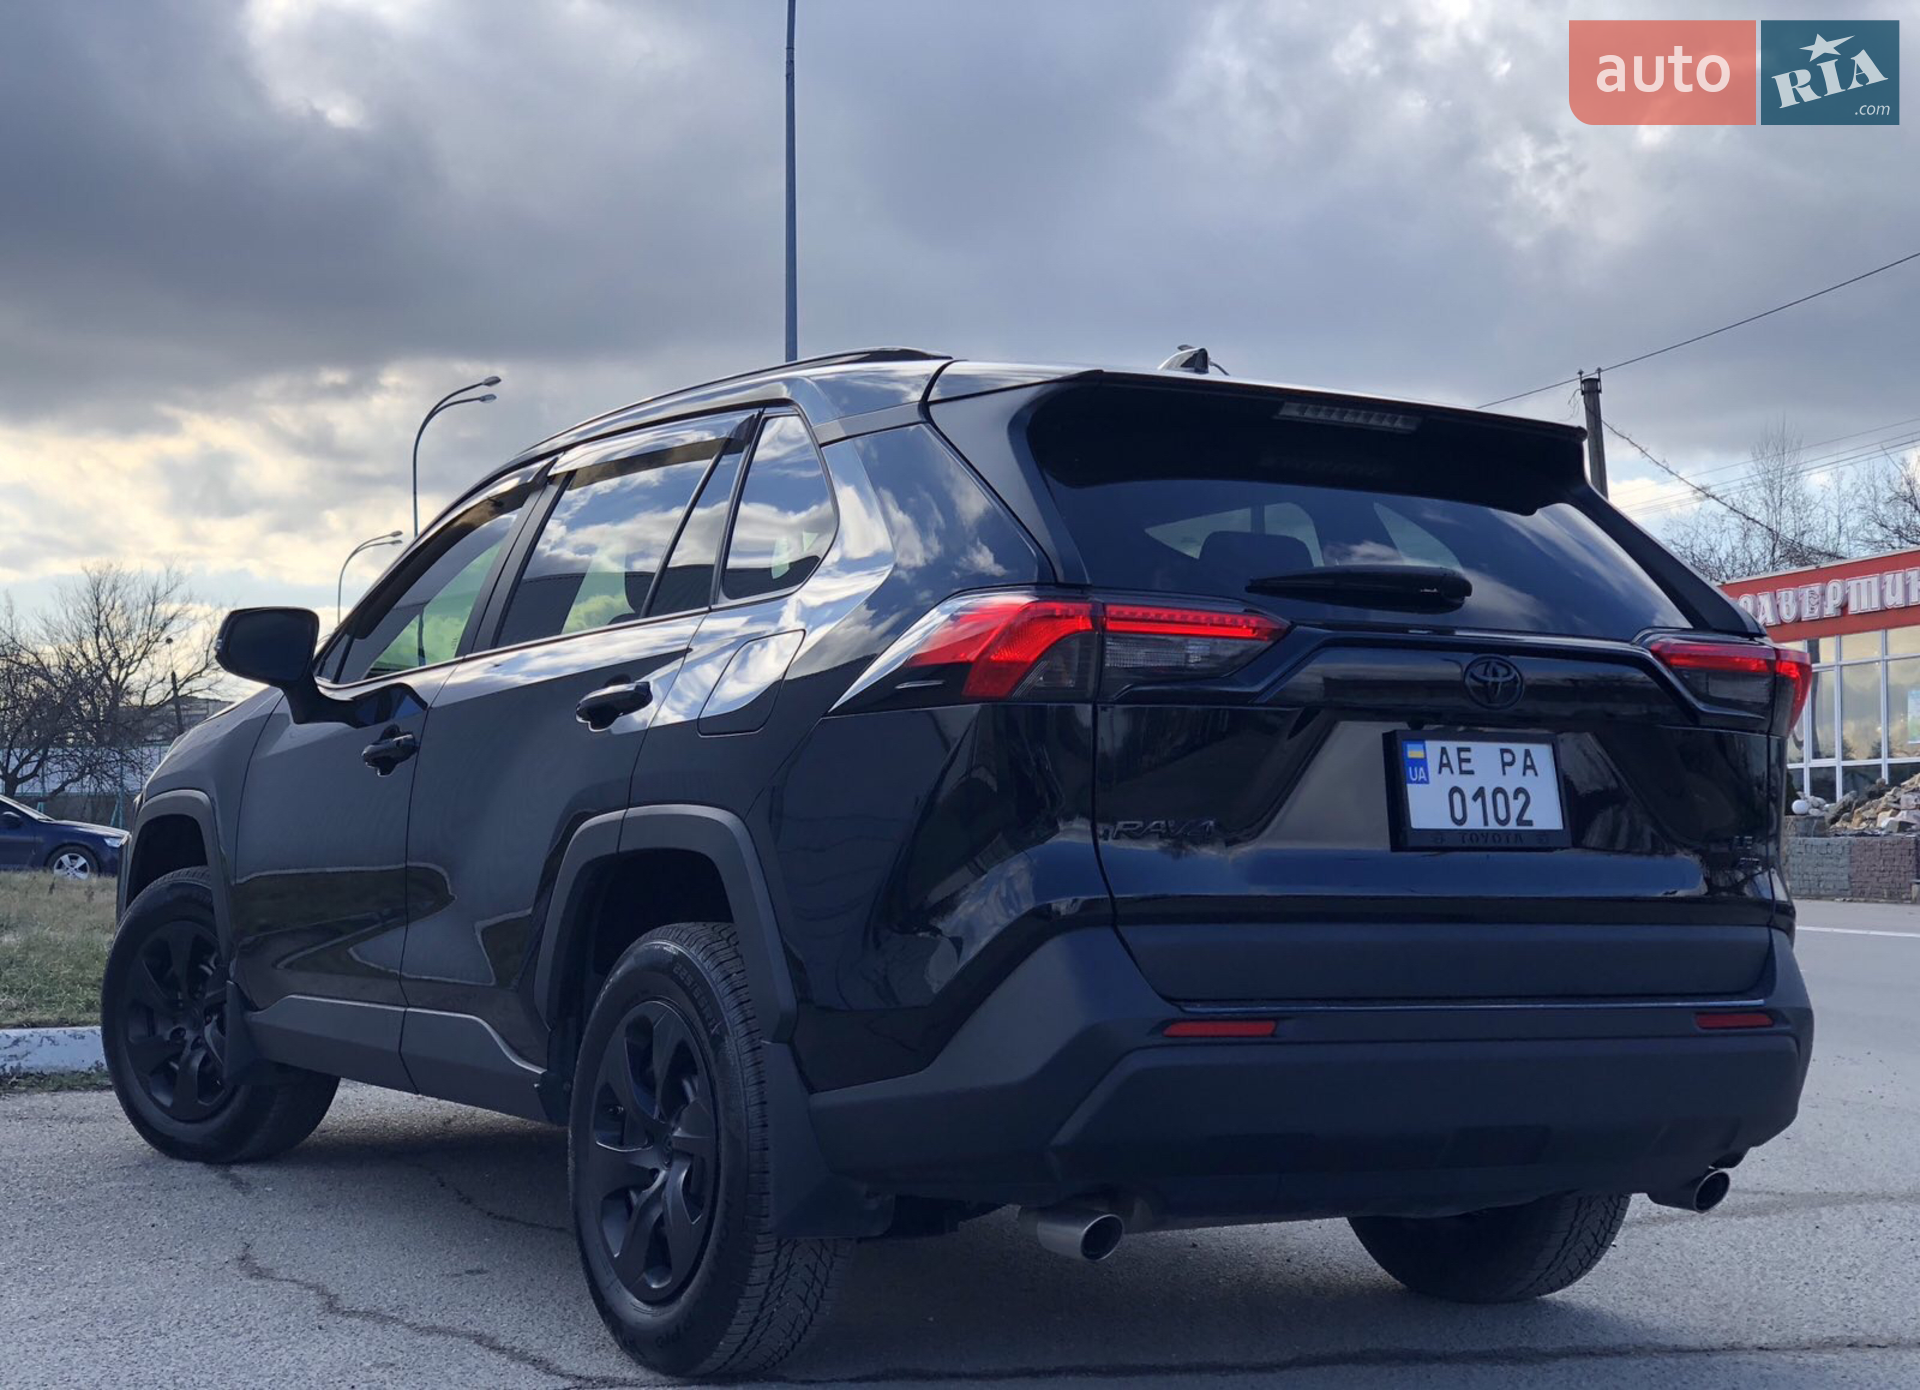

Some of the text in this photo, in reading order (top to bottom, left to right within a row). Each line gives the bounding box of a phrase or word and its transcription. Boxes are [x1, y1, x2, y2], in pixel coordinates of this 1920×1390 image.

[1438, 747, 1538, 777] AE PA
[1409, 766, 1427, 782] UA
[1448, 785, 1534, 827] 0102
[1459, 832, 1525, 845] TOYOTA
